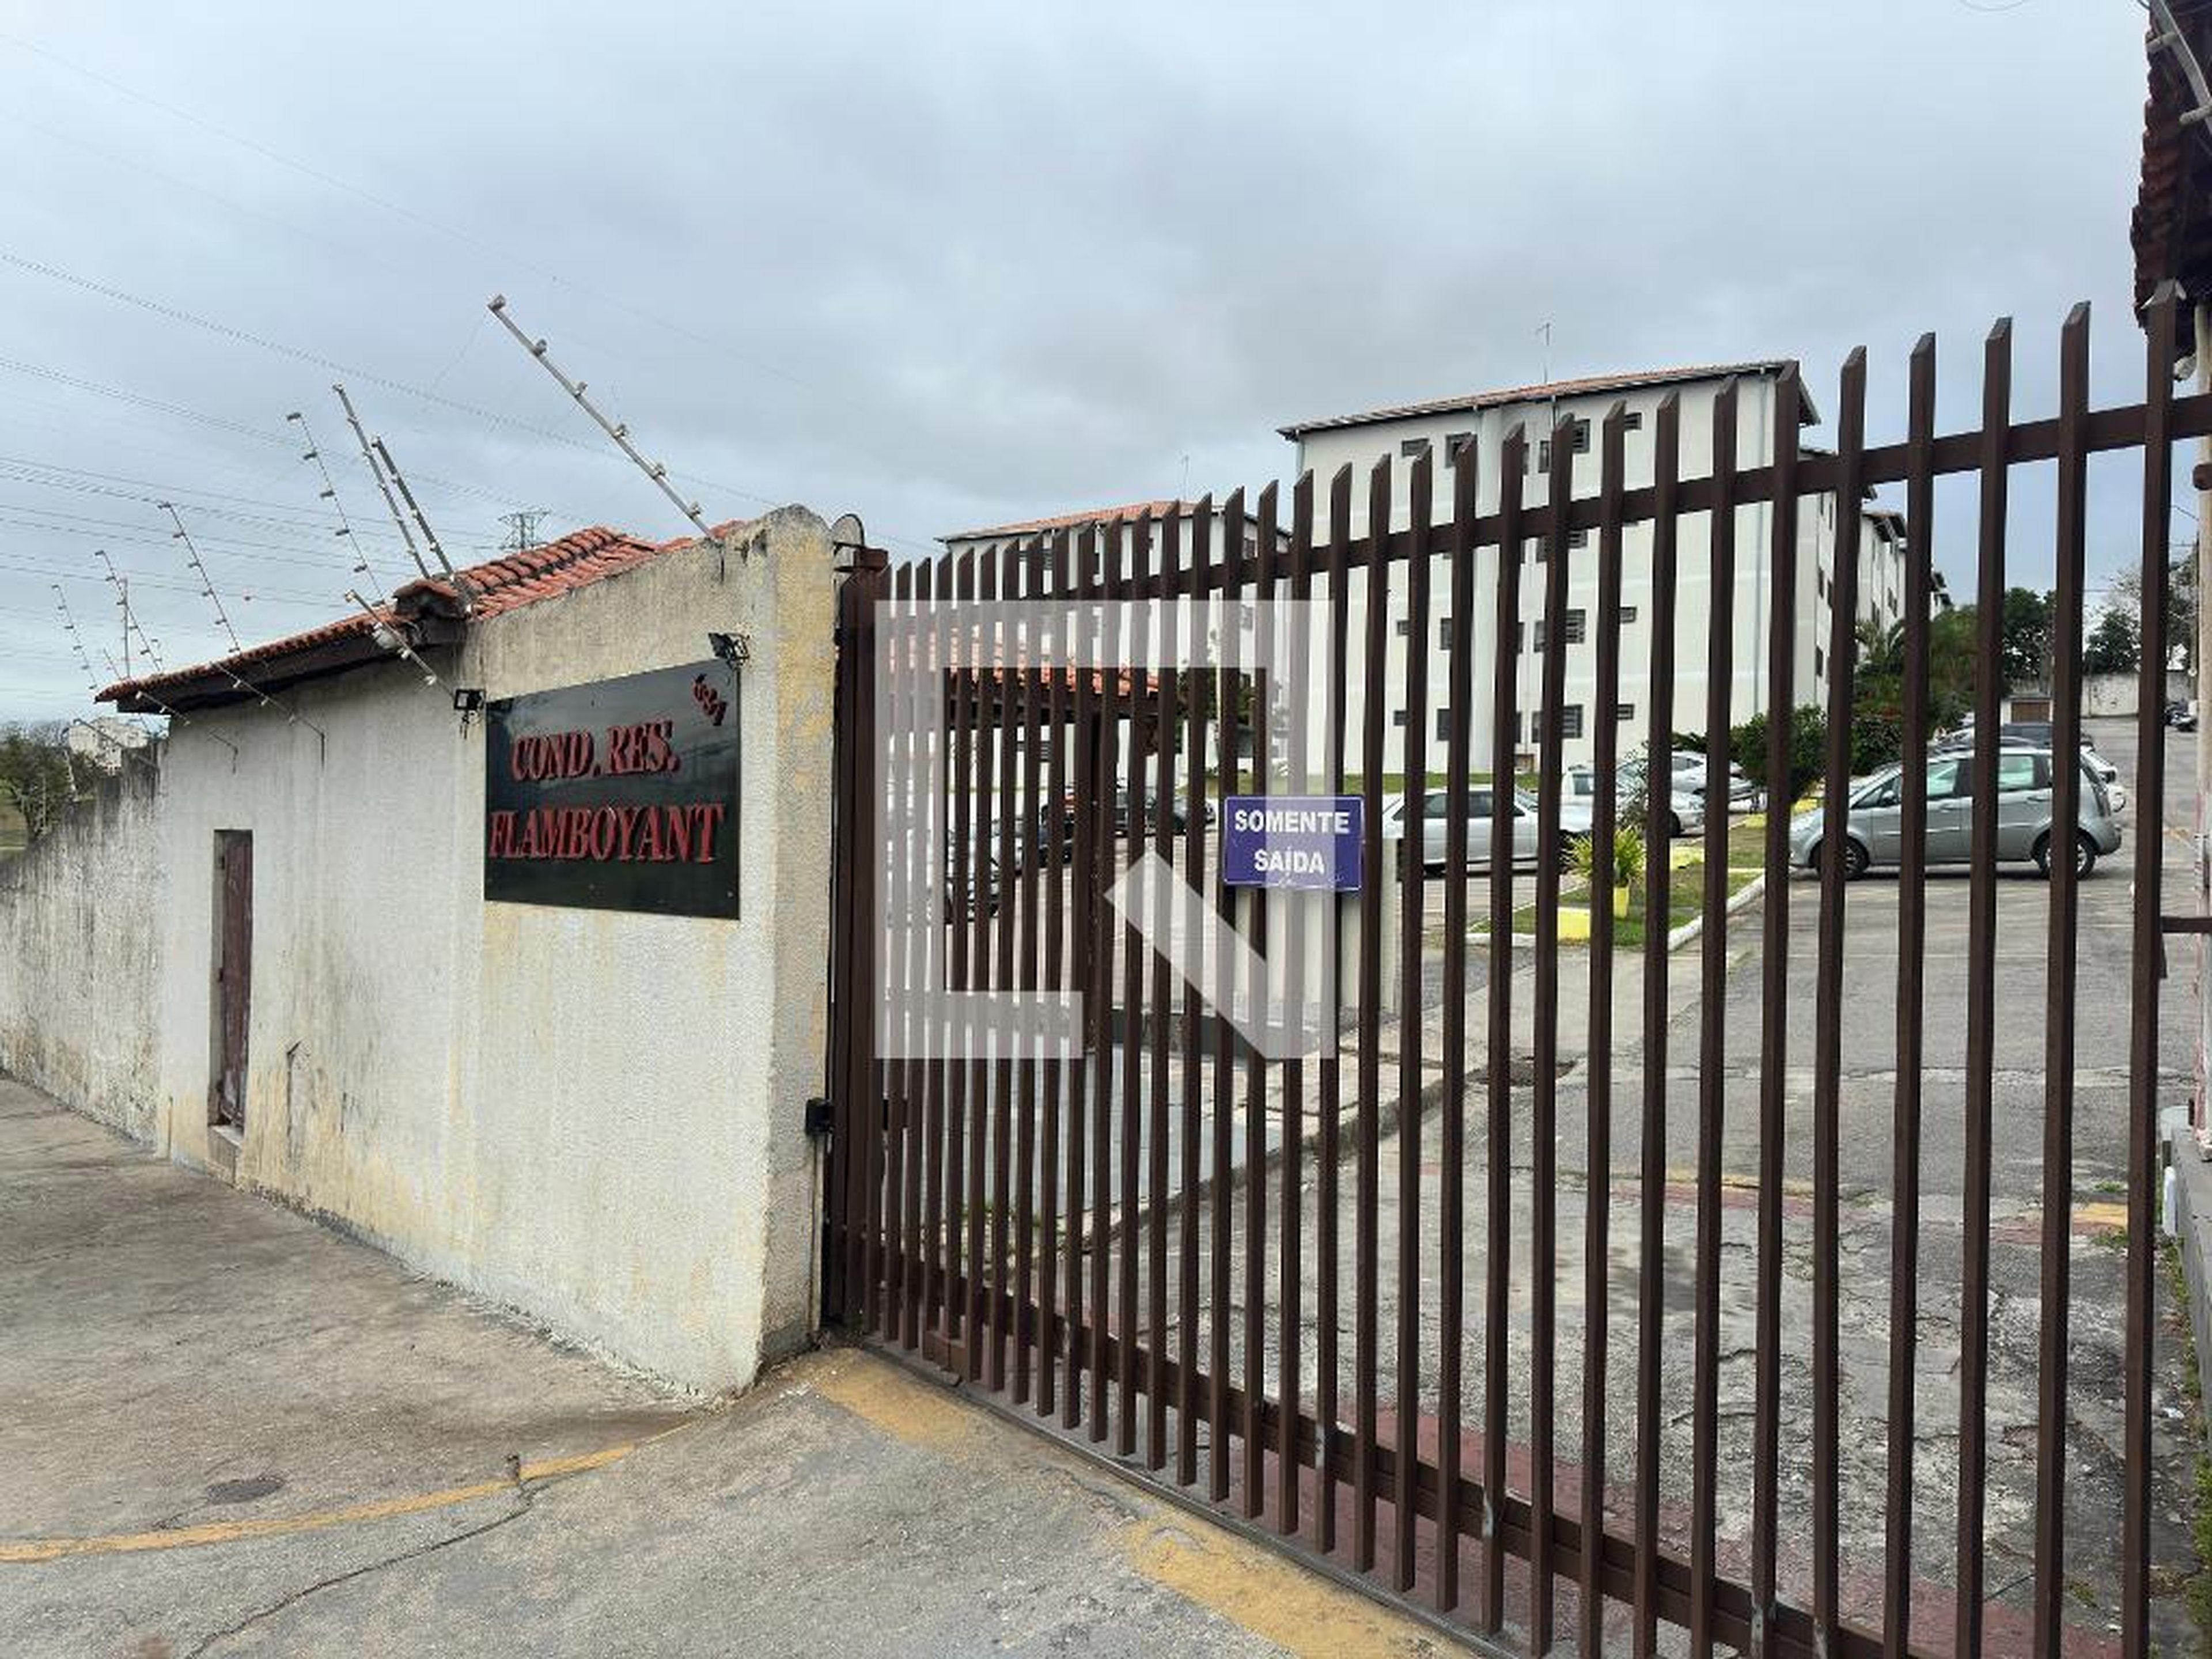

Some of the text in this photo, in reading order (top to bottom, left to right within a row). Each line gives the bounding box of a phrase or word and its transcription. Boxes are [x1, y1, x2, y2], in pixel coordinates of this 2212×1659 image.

[512, 720, 681, 781] COND. RES.
[489, 804, 724, 864] FLAMBOYANT
[1234, 809, 1350, 834] SOMENTE
[1253, 844, 1325, 874] SAÍDA
